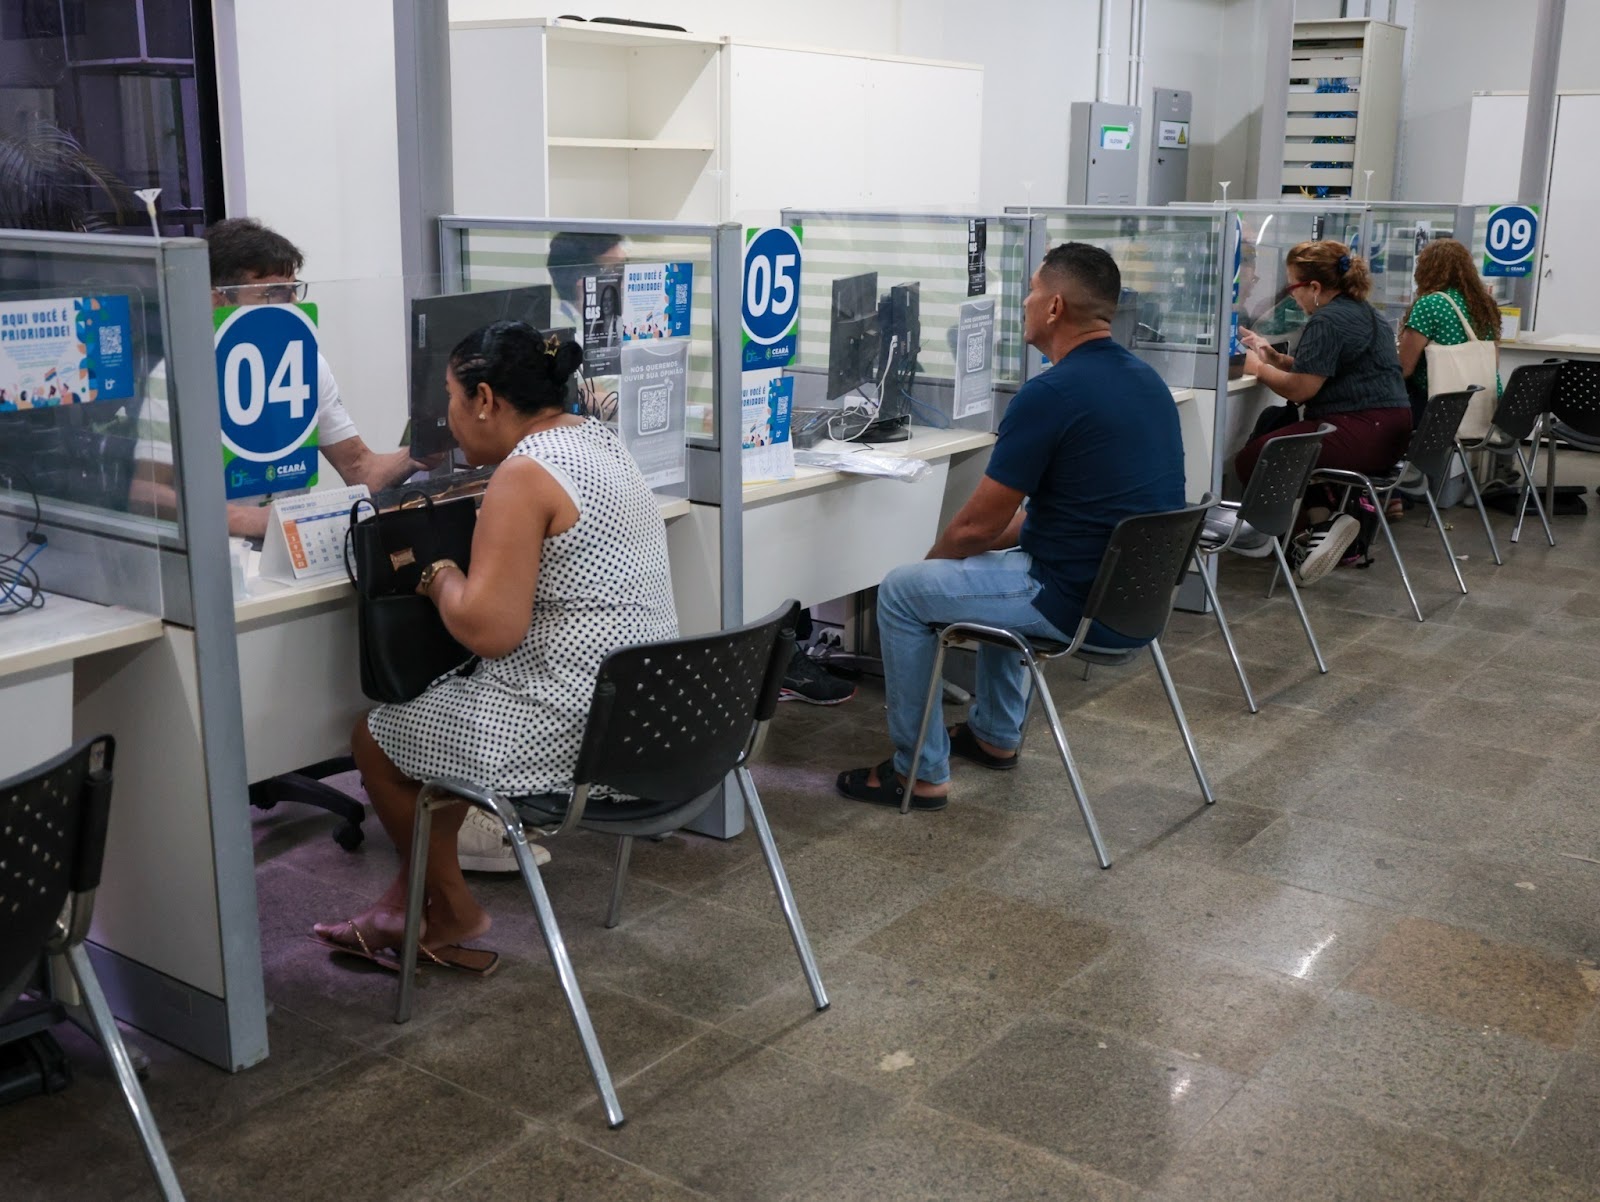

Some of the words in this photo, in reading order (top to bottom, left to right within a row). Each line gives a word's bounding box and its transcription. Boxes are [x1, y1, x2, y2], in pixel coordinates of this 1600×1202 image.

[1490, 218, 1532, 250] 09
[628, 273, 642, 282] AQUI
[644, 270, 656, 280] VOCÊ
[628, 282, 662, 292] PRIORIDADE!
[746, 254, 796, 317] 05
[586, 294, 596, 306] VA
[2, 313, 28, 327] AQUI
[32, 308, 57, 323] VOCÊ
[62, 307, 67, 321] É
[586, 306, 601, 319] GAS
[1, 326, 70, 341] PRIORIDADE!
[772, 346, 789, 356] CEARÁ
[630, 365, 644, 373] NÓS
[646, 361, 678, 372] QUEREMOS
[660, 368, 684, 378] OPINIÃO
[224, 340, 310, 426] 04
[277, 460, 306, 474] CEARÁ
